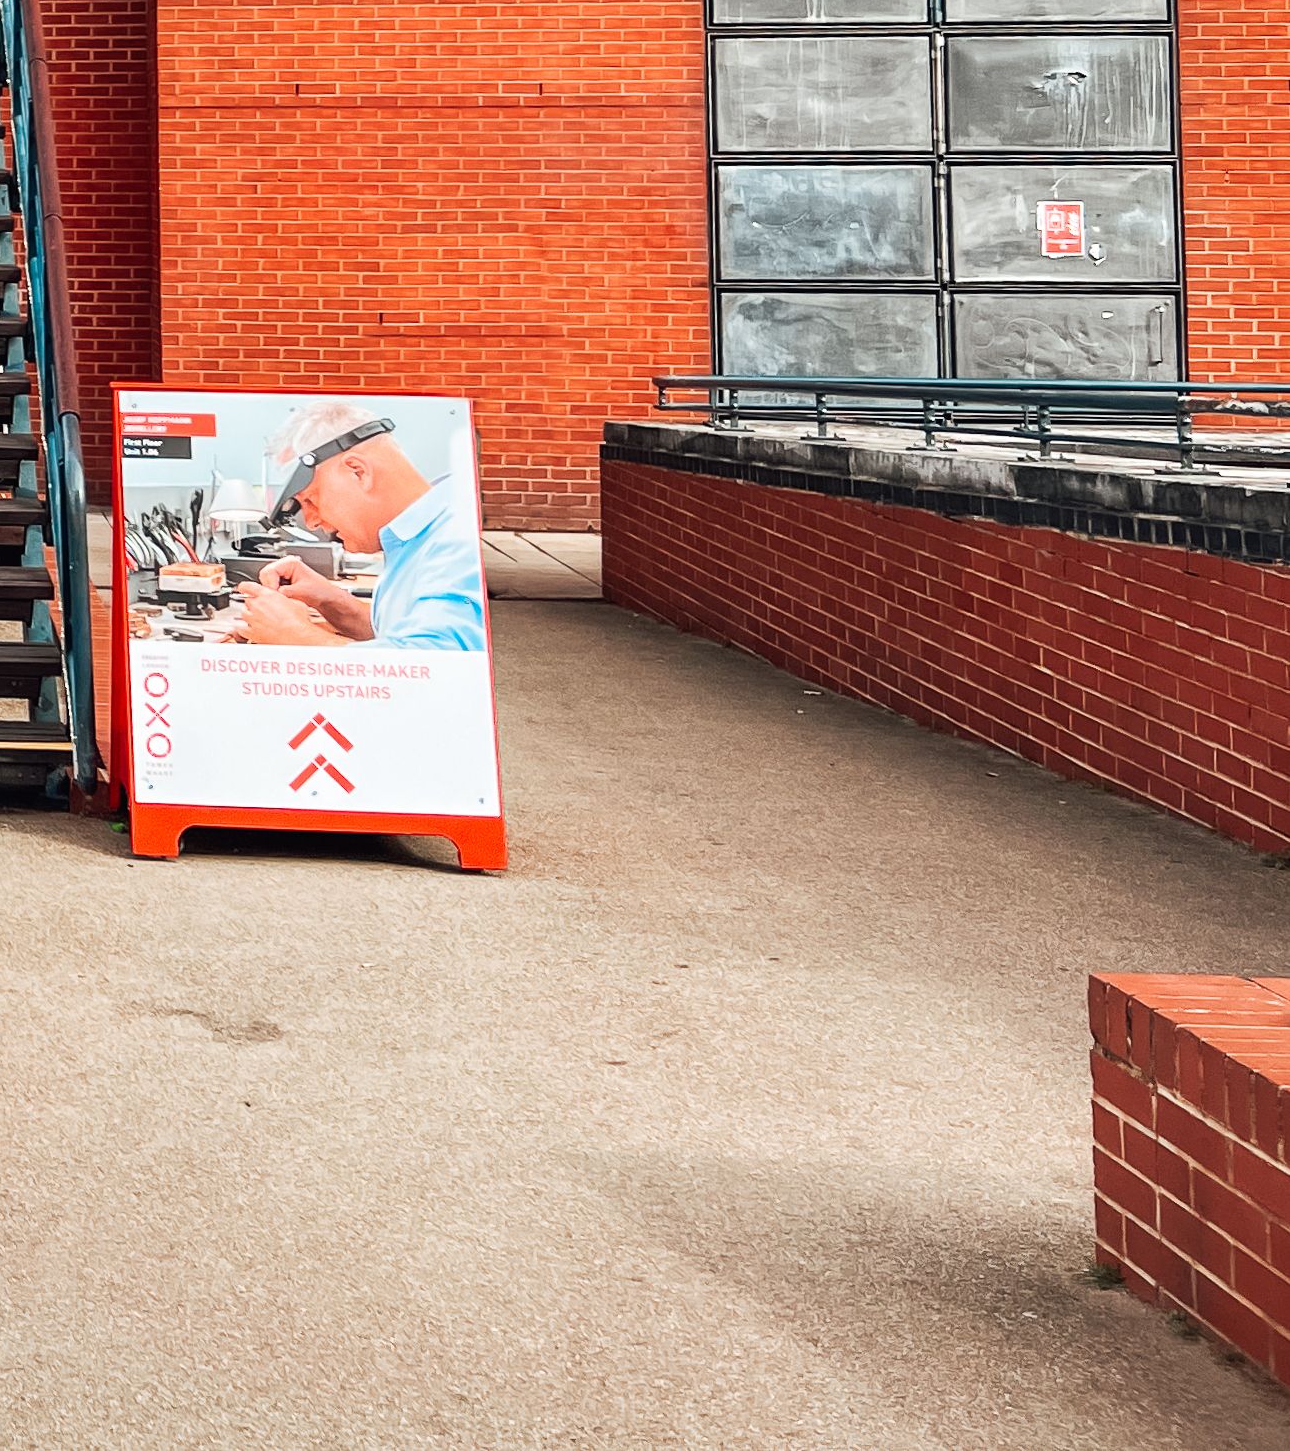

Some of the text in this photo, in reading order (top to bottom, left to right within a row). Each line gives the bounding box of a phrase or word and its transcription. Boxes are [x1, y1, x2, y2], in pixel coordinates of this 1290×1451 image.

[202, 659, 429, 678] DISCOVER DESIGNER-MAKER
[243, 682, 390, 699] STUDIOS UPSTAIRS
[145, 673, 171, 757] OXO
